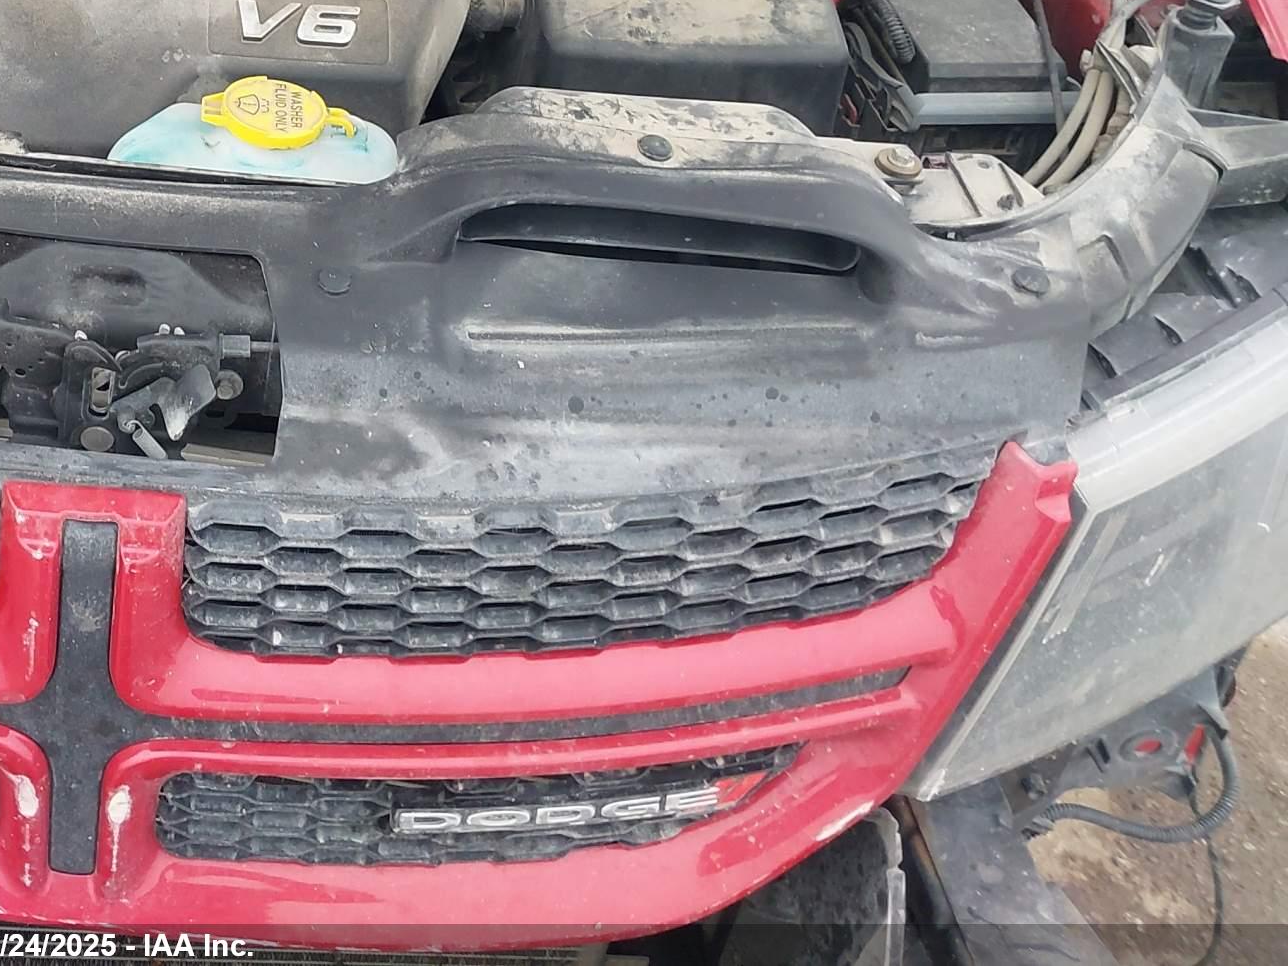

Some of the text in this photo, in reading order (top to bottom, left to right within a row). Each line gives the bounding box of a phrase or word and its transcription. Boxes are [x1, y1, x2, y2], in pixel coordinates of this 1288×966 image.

[275, 83, 289, 133] FLUID ONLY
[290, 91, 304, 128] WASHER
[398, 786, 720, 833] DODGE
